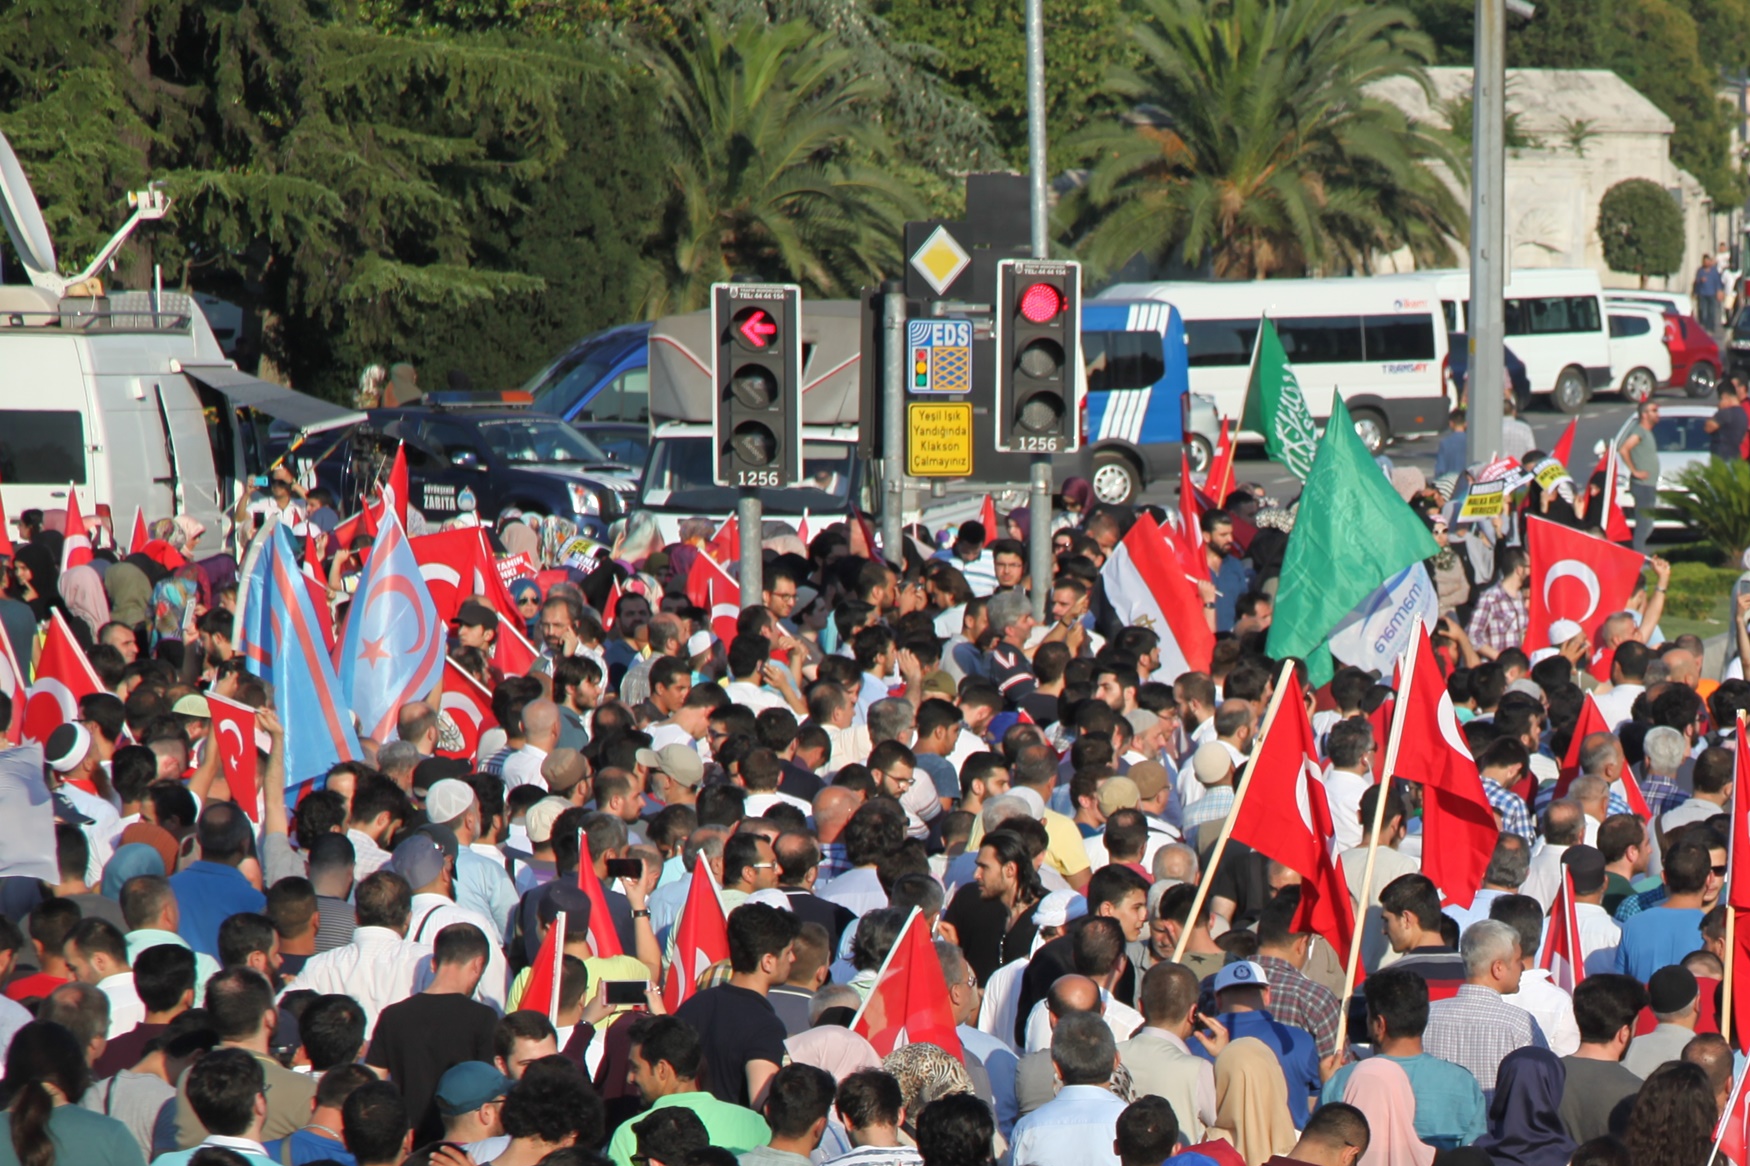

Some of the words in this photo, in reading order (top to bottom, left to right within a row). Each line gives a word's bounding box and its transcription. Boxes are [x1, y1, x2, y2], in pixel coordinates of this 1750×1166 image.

[932, 323, 969, 346] EDS
[918, 410, 942, 421] Yeşil
[944, 410, 961, 421] Işık
[914, 425, 967, 438] Yandığında
[920, 440, 960, 451] Klakson
[1019, 436, 1057, 451] 1256
[914, 456, 967, 469] Çalmayınız
[737, 471, 779, 486] 1256
[423, 494, 456, 511] ZABITA
